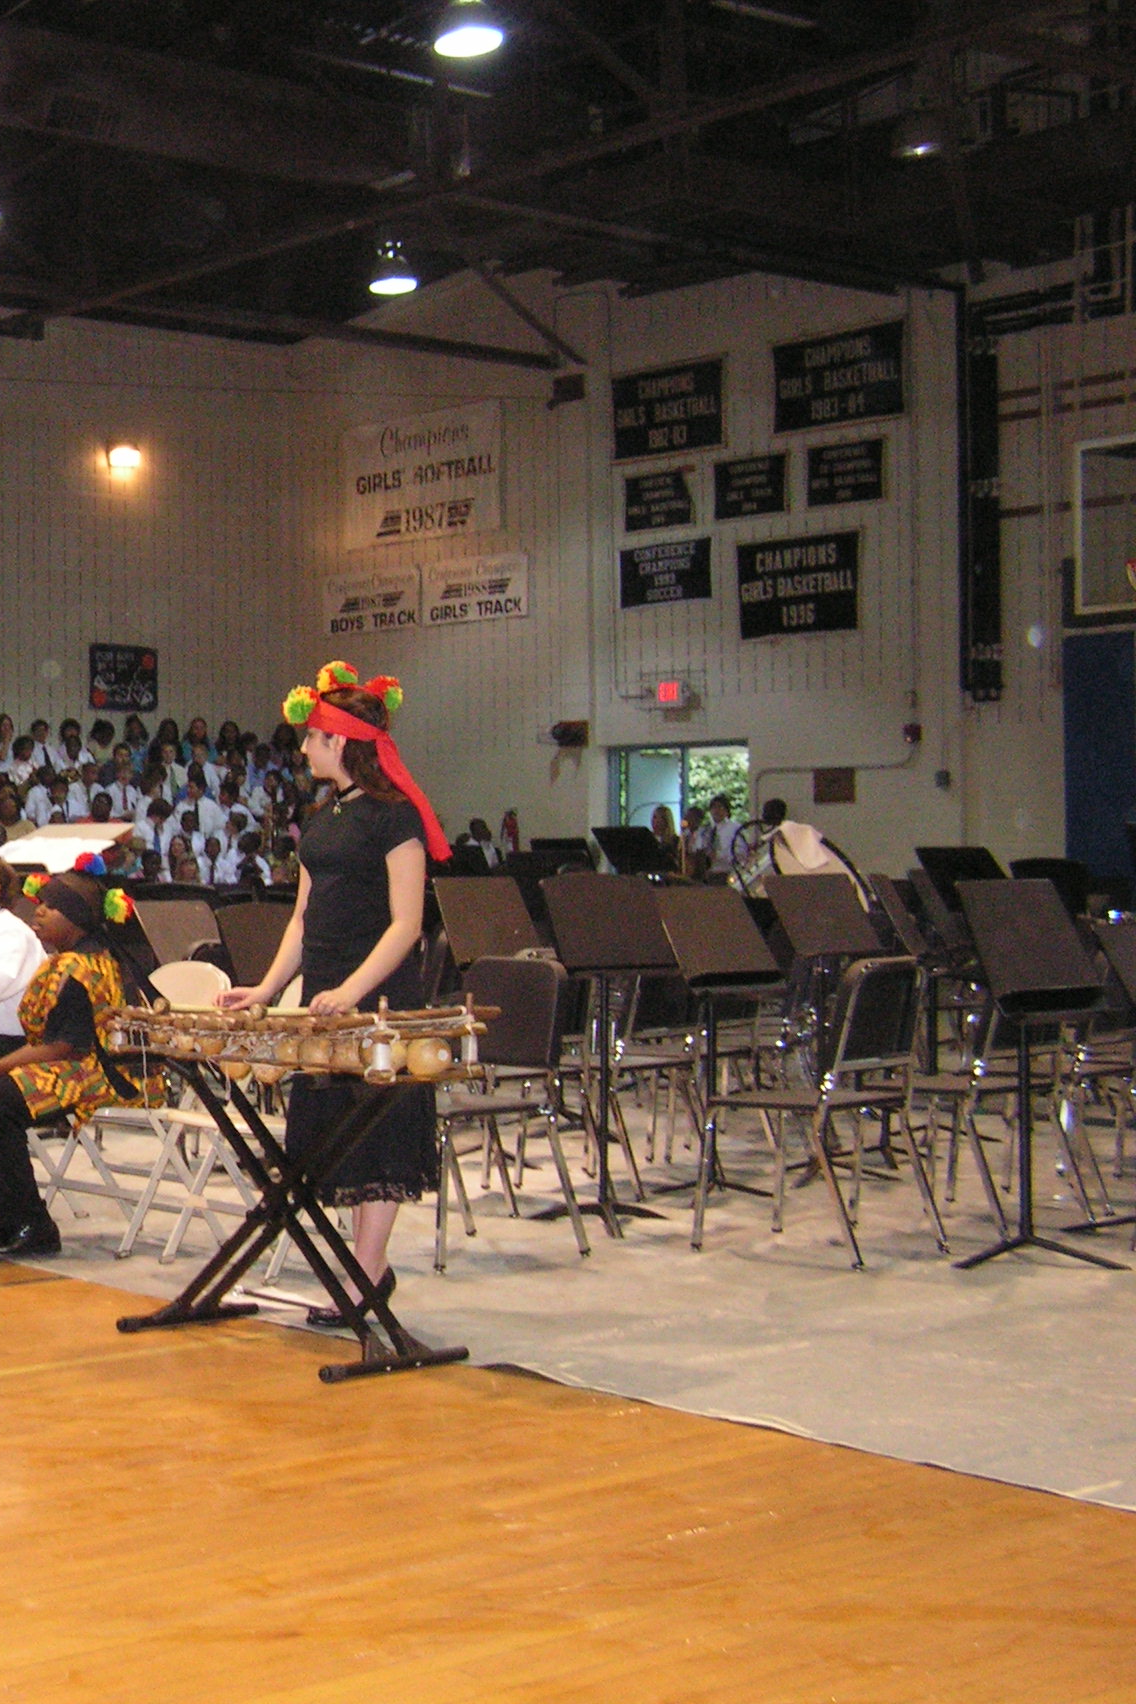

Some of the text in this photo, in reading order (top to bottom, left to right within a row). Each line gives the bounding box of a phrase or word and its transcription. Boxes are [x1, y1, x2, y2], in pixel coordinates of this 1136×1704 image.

[380, 424, 469, 458] Champions
[414, 454, 495, 485] SOFTBALL
[404, 502, 447, 533] 1987
[756, 542, 837, 574] CHAMPIONS
[777, 568, 854, 598] BASKETBALL
[372, 609, 416, 628] TRACK
[477, 598, 522, 617] TRACK
